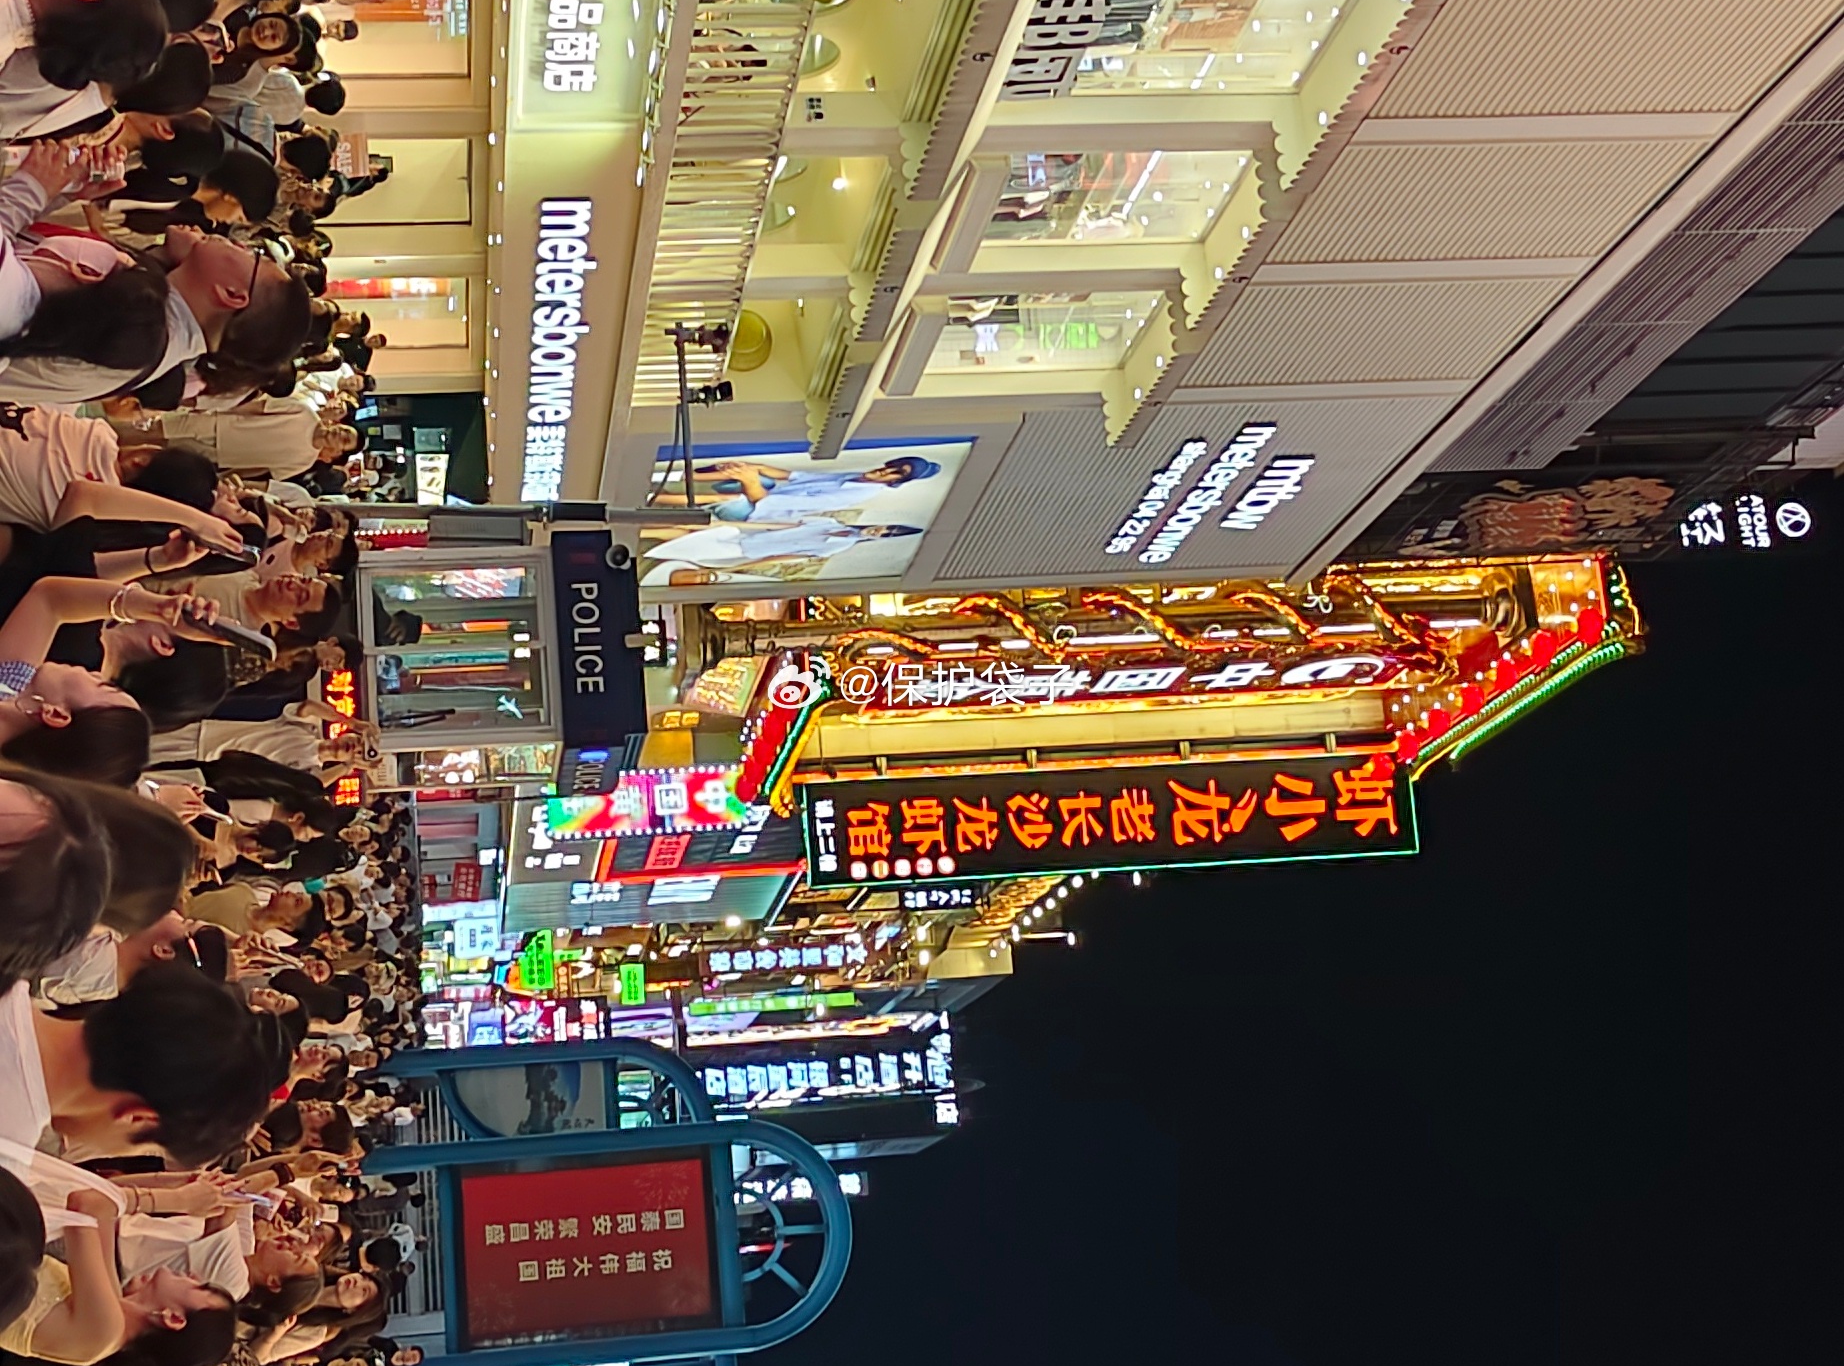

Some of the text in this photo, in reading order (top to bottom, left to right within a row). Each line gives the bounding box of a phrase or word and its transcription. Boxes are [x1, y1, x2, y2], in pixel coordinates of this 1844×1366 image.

[527, 199, 597, 423] metersbonwe
[1138, 425, 1277, 564] metersbonwe
[1735, 496, 1755, 547] LIGHT
[1749, 495, 1771, 548] ATOUR
[571, 583, 605, 693] POLICE
[846, 765, 1399, 859] 虾小龙老长沙龙虾馆
[484, 1209, 685, 1246] 国泰民安 繁荣昌盛
[518, 1249, 673, 1282] 祝福伟大祖国
